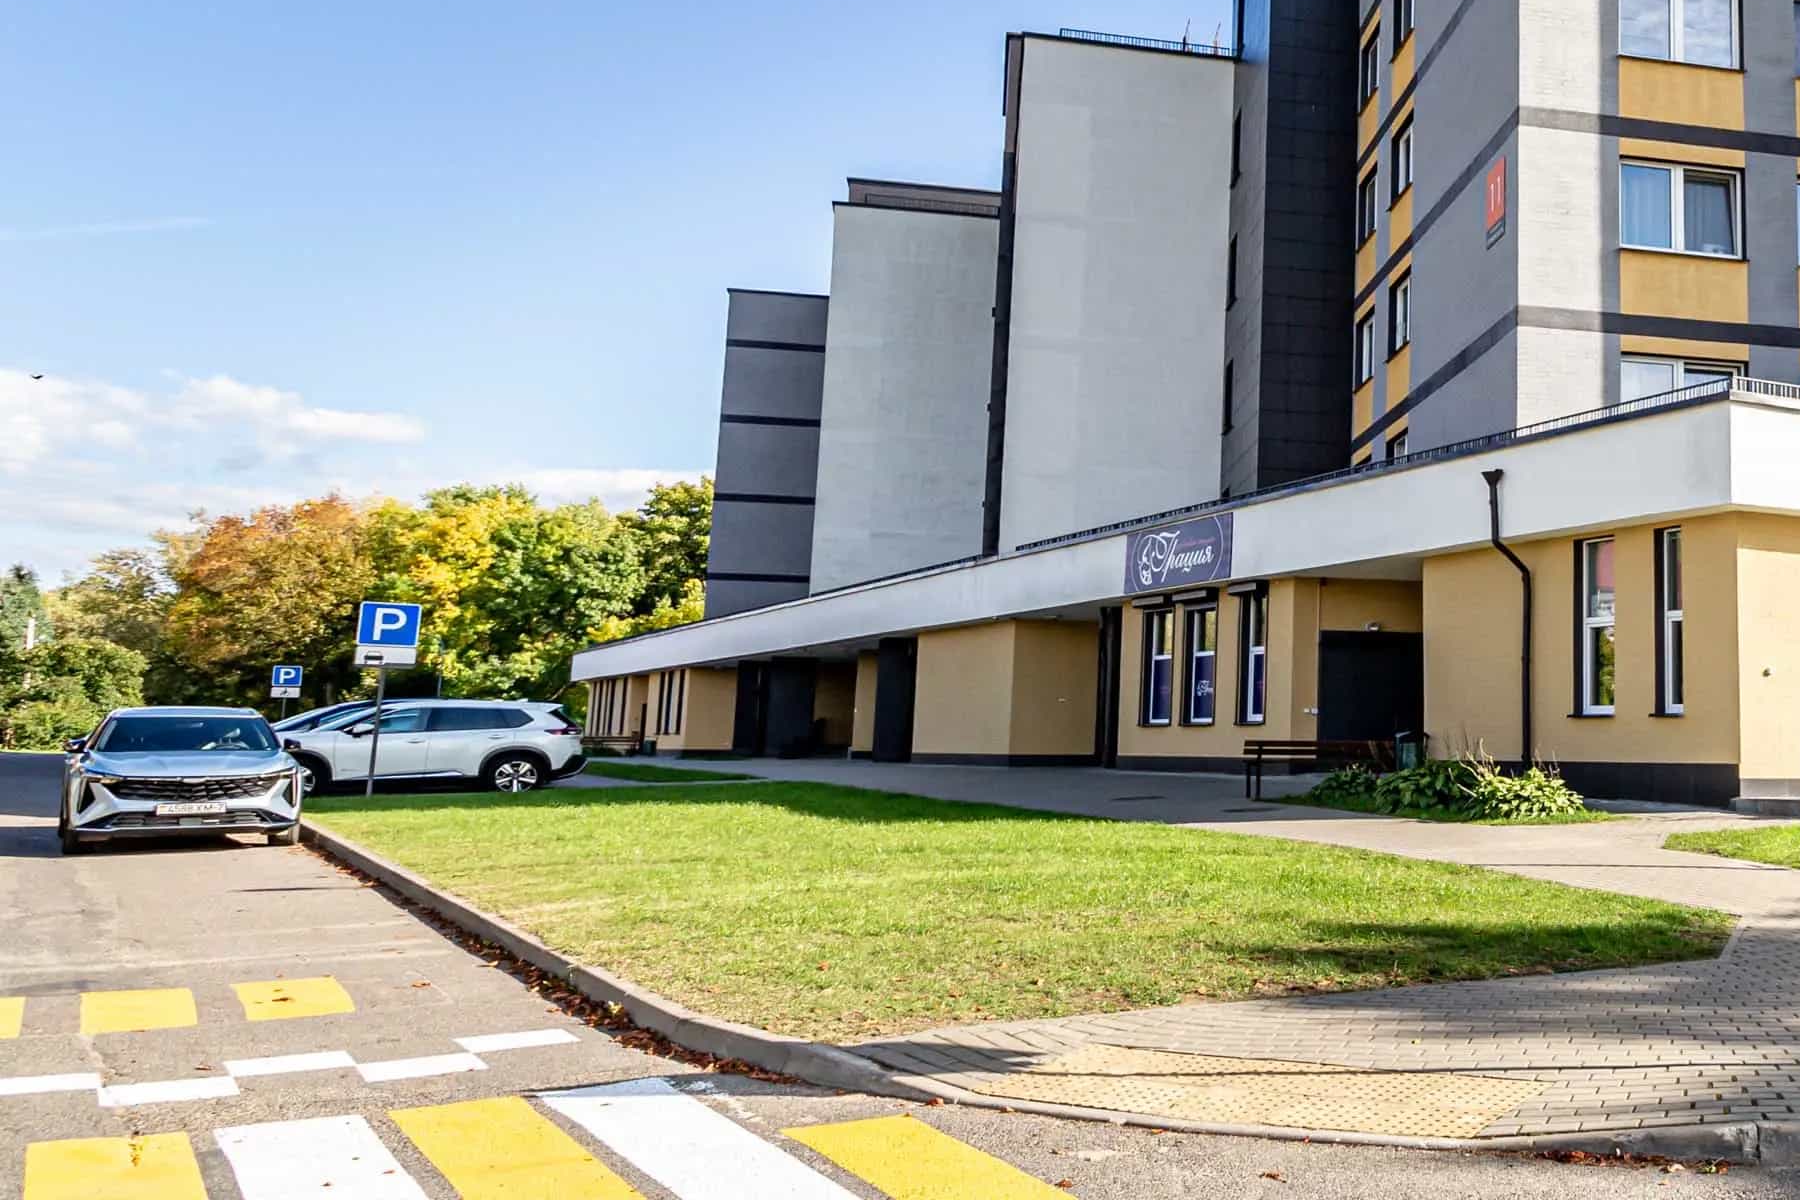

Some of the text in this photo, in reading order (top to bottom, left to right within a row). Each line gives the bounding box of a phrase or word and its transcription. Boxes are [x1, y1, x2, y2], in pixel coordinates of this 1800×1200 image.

[1150, 530, 1215, 583] Грация
[372, 607, 408, 641] P
[279, 668, 296, 684] P
